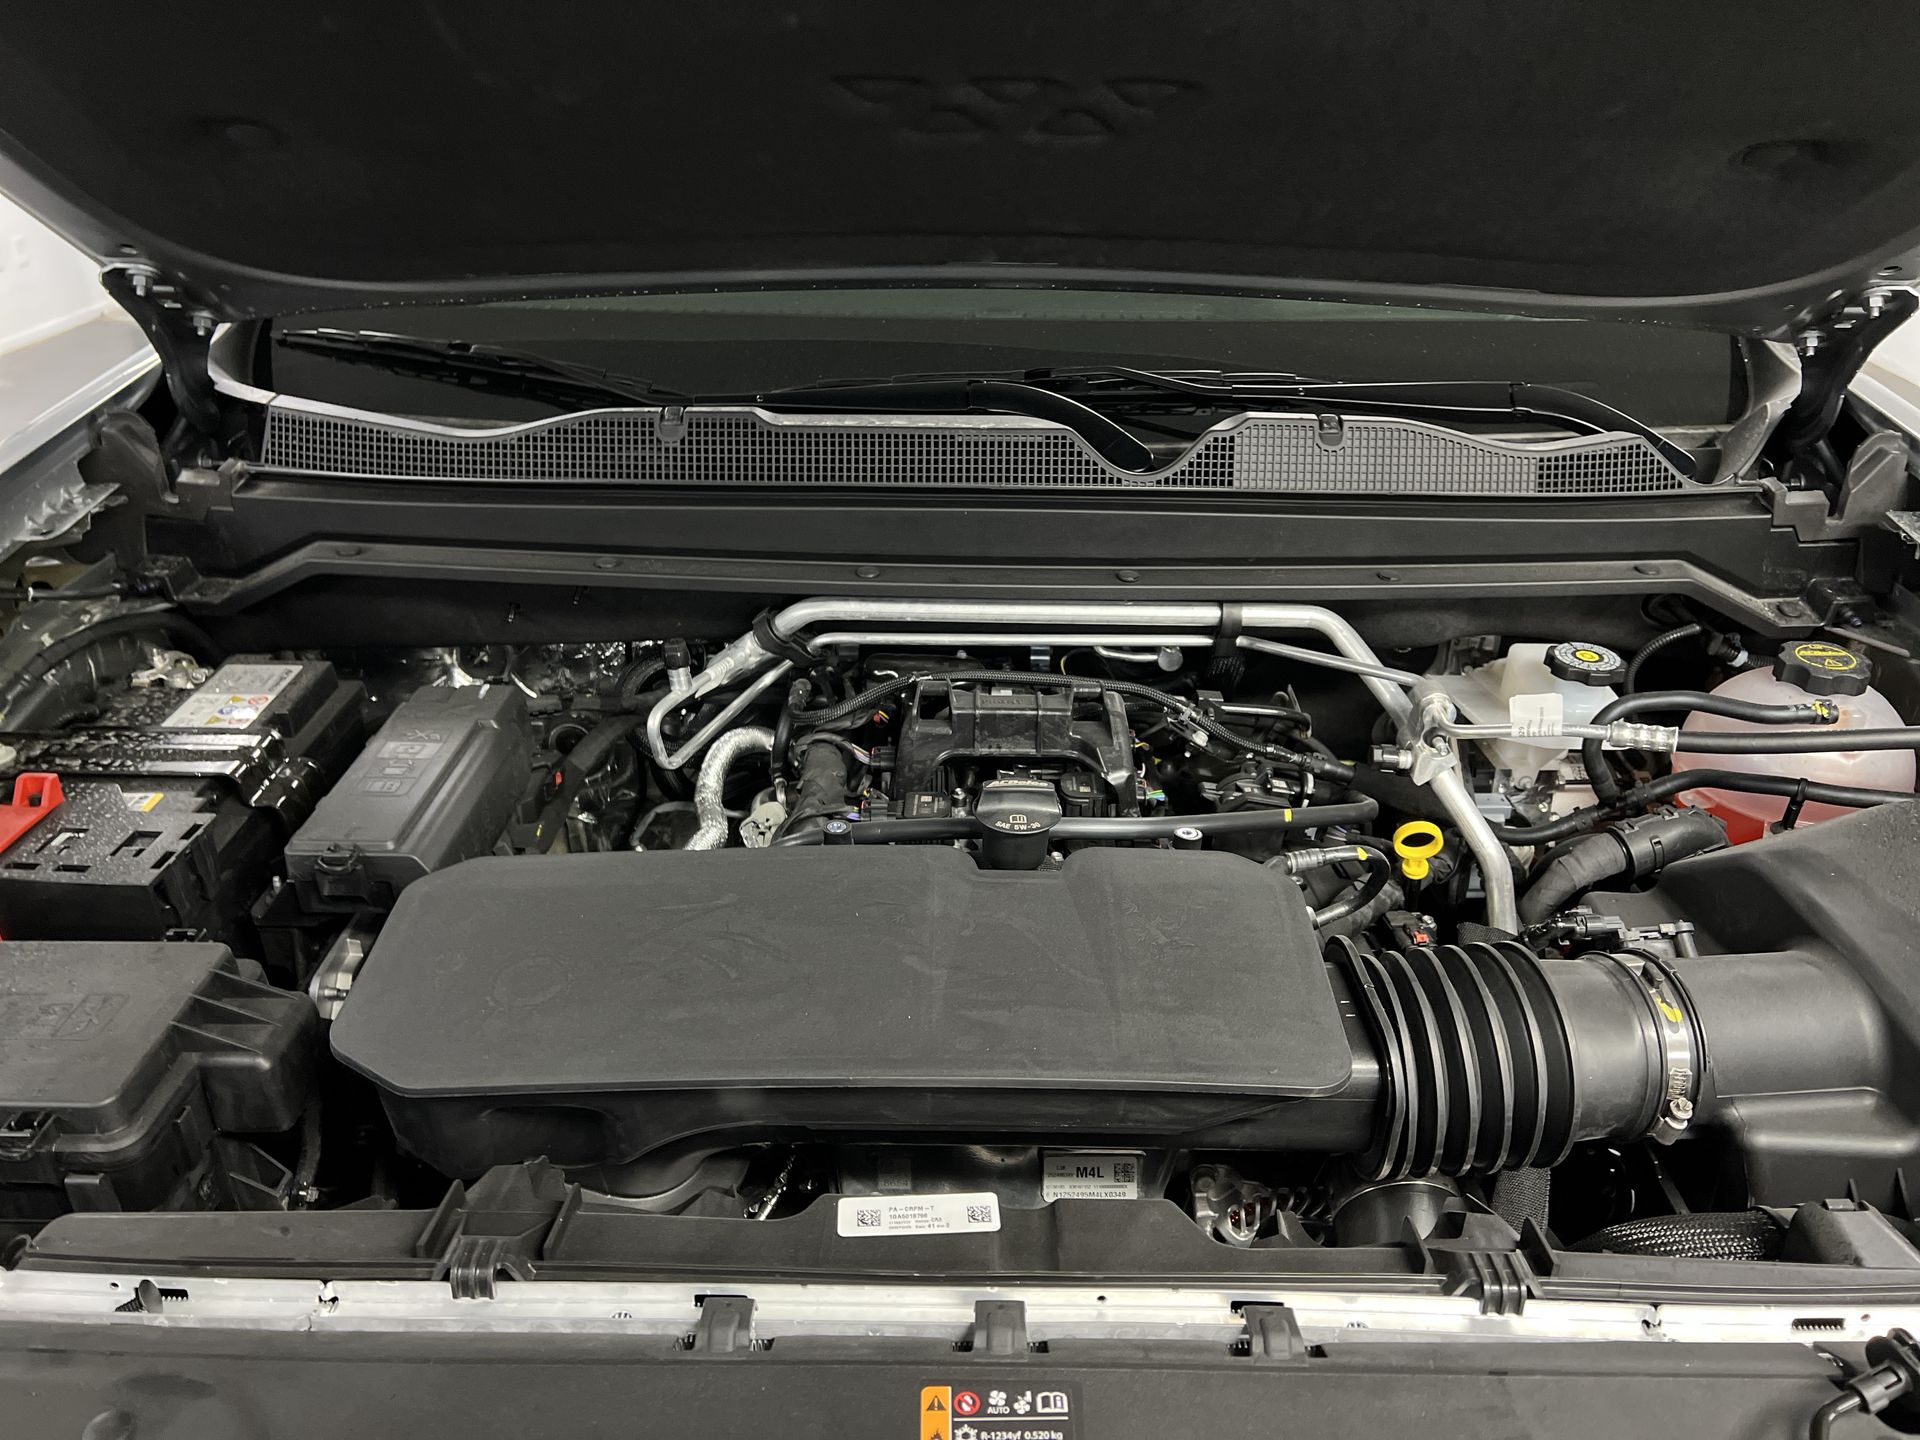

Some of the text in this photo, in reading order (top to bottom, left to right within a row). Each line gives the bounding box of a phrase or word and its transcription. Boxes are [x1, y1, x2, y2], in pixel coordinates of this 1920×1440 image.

[995, 821, 1041, 830] SAE 5W-30
[1075, 1166, 1105, 1178] M4L
[980, 1430, 1064, 1440] R-1234yf 0.520 kg
